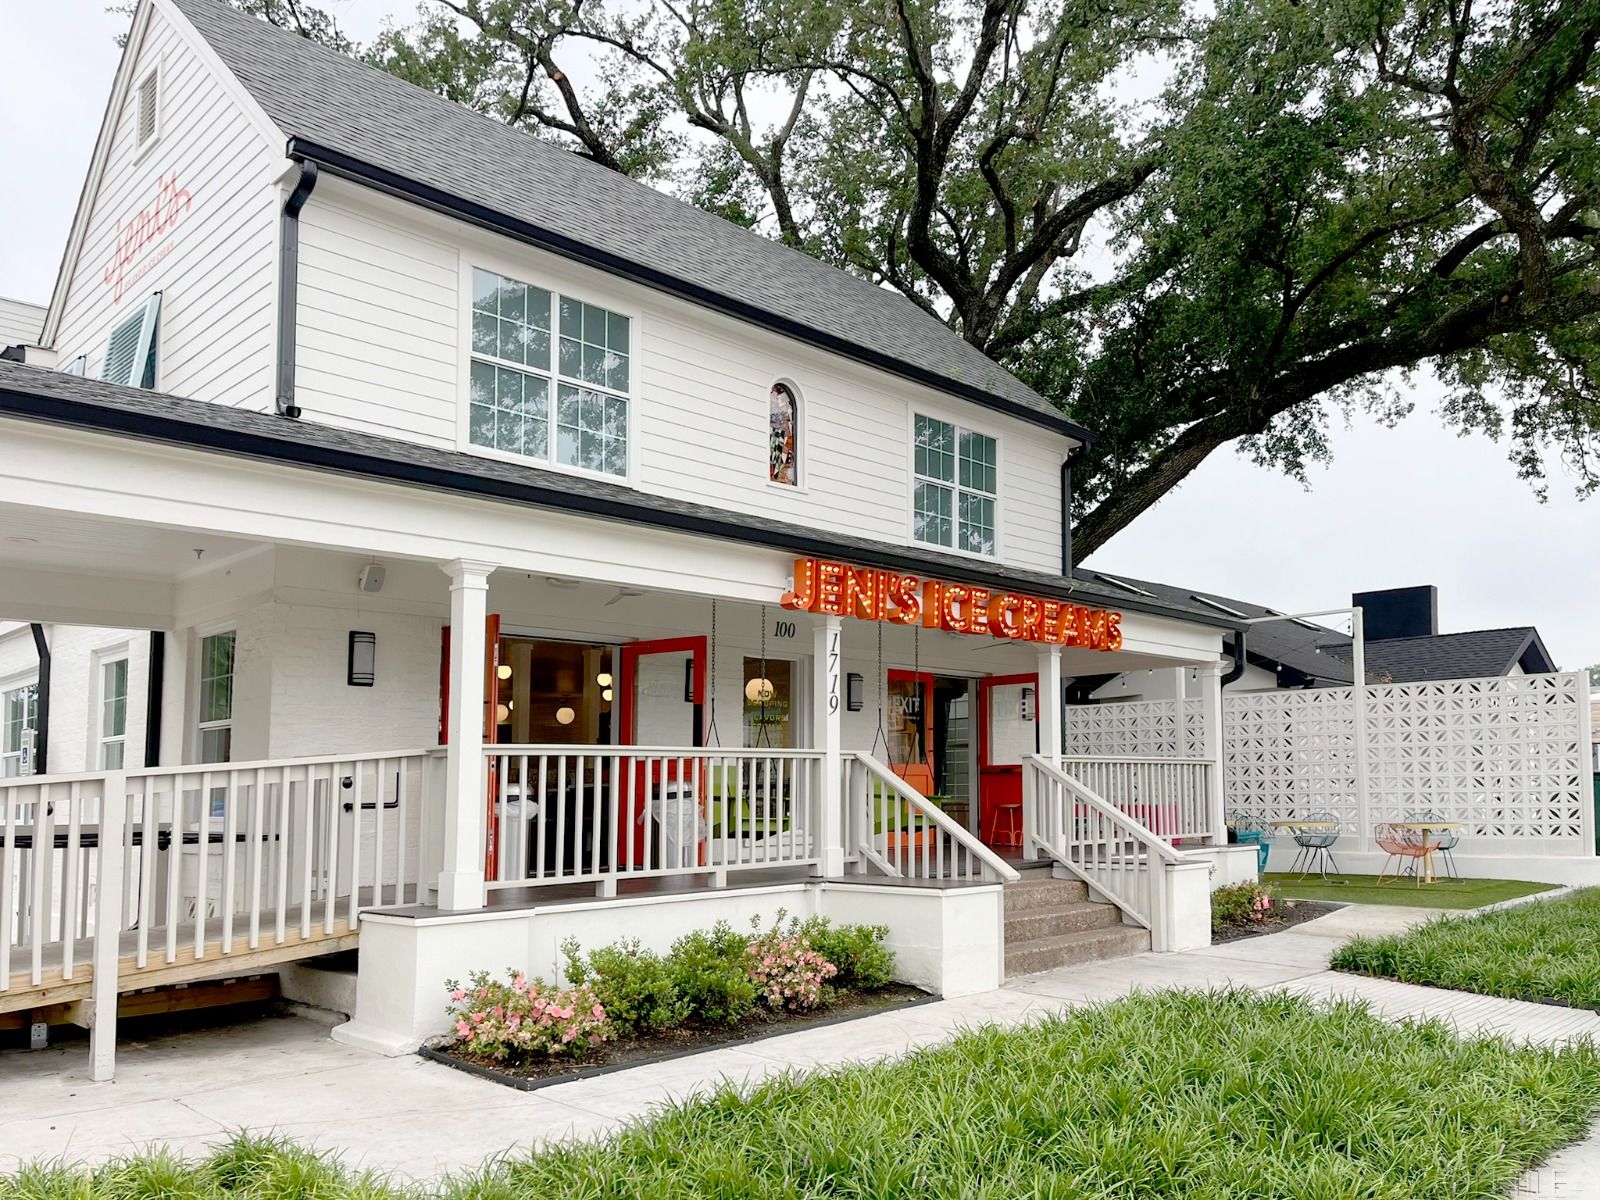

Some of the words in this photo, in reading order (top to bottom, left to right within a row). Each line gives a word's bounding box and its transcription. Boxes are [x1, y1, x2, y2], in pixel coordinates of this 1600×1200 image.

[104, 170, 192, 305] jeni's
[774, 621, 796, 638] 100
[781, 557, 919, 624] JENI'S
[923, 579, 990, 633] ICE
[988, 593, 1123, 651] CREAMS
[828, 632, 839, 716] 1719
[893, 695, 920, 713] EXIT
